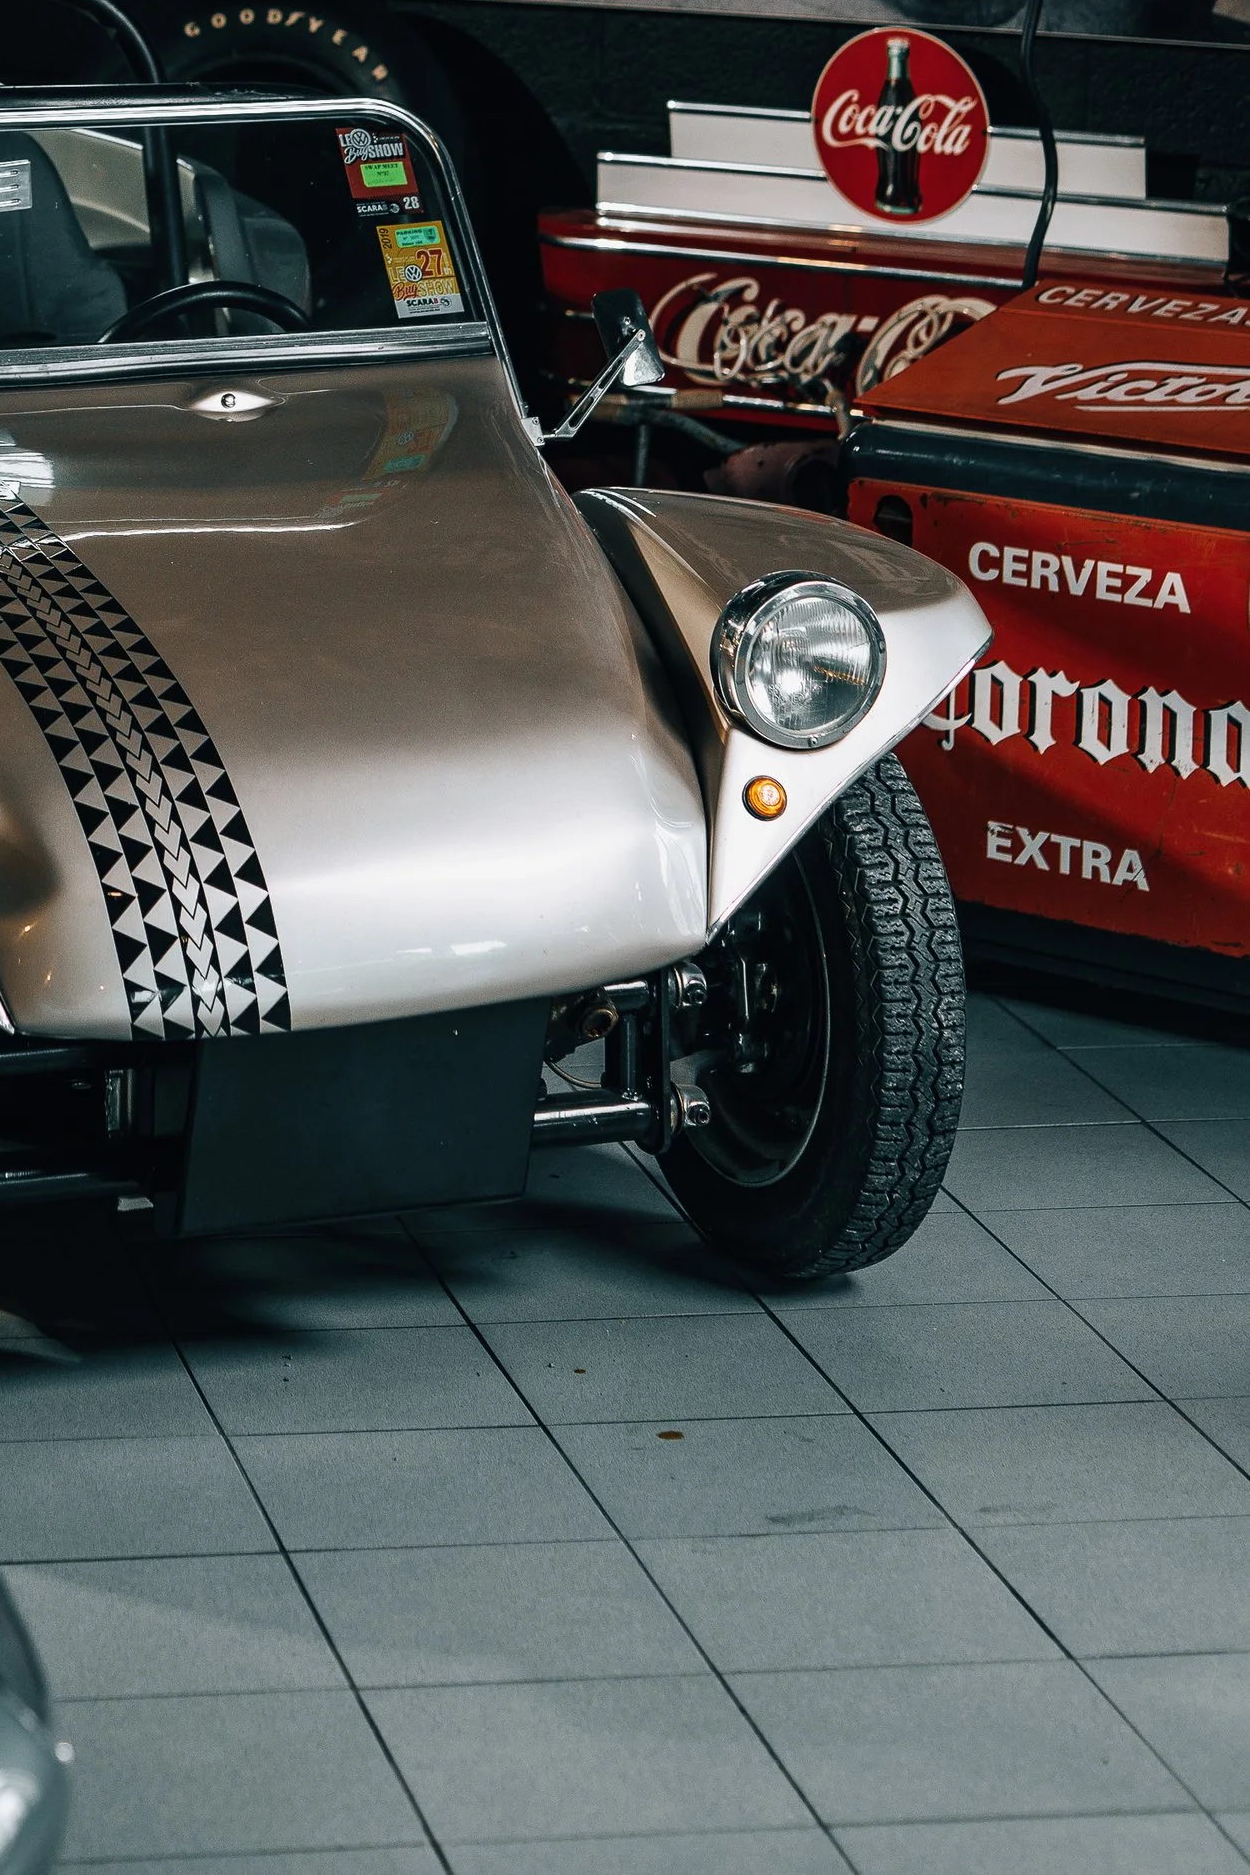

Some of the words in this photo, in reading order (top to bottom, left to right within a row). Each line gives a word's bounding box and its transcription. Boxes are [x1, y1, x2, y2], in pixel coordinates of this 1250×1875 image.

[184, 8, 388, 82] GOODYEAR
[822, 89, 978, 156] Coca-Cola
[368, 142, 404, 159] SHOW
[403, 196, 420, 210] 28
[378, 228, 392, 249] 2019
[415, 247, 443, 278] 27
[406, 296, 439, 307] SCARAB
[416, 277, 456, 298] SHOW
[1036, 285, 1250, 326] CERVEZA
[968, 541, 1191, 614] CERVEZA
[986, 820, 1150, 892] EXTRA
